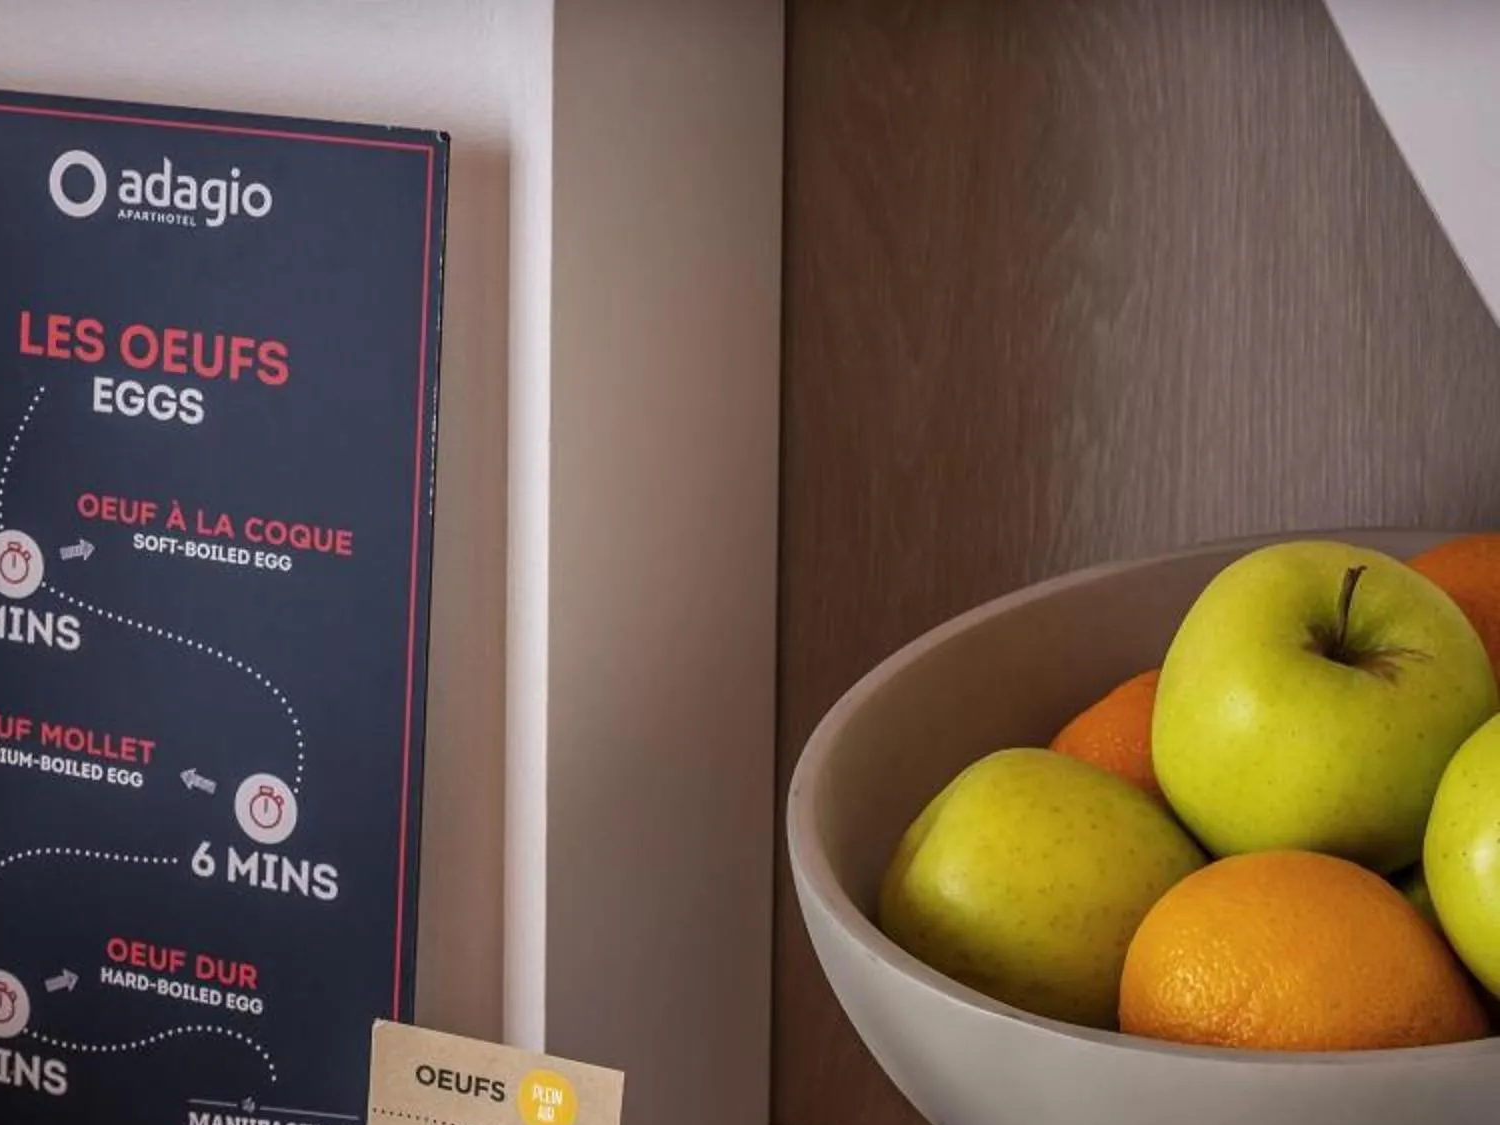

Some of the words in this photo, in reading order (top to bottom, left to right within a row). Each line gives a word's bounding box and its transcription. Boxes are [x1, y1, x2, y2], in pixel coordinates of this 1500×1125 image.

[118, 156, 272, 227] adagio
[118, 210, 197, 227] APARTHOTEL
[19, 311, 106, 363] LES
[120, 324, 289, 385] OEUFS
[93, 376, 205, 425] EGGS
[77, 493, 158, 526] OEUF
[166, 500, 187, 531] À
[197, 509, 235, 539] LA
[245, 516, 353, 556] COQUE
[133, 533, 250, 565] SOFT-BOILED
[254, 551, 293, 571] EGG
[41, 721, 156, 764] MOLLET
[107, 766, 143, 787] EGG
[192, 841, 216, 877] 6
[227, 846, 338, 901] MINS
[107, 937, 186, 973] OEUF
[195, 954, 258, 990] DUR
[100, 967, 222, 1006] HARD-BOILED
[225, 993, 264, 1015] EGG
[416, 1064, 505, 1102] OEUFS
